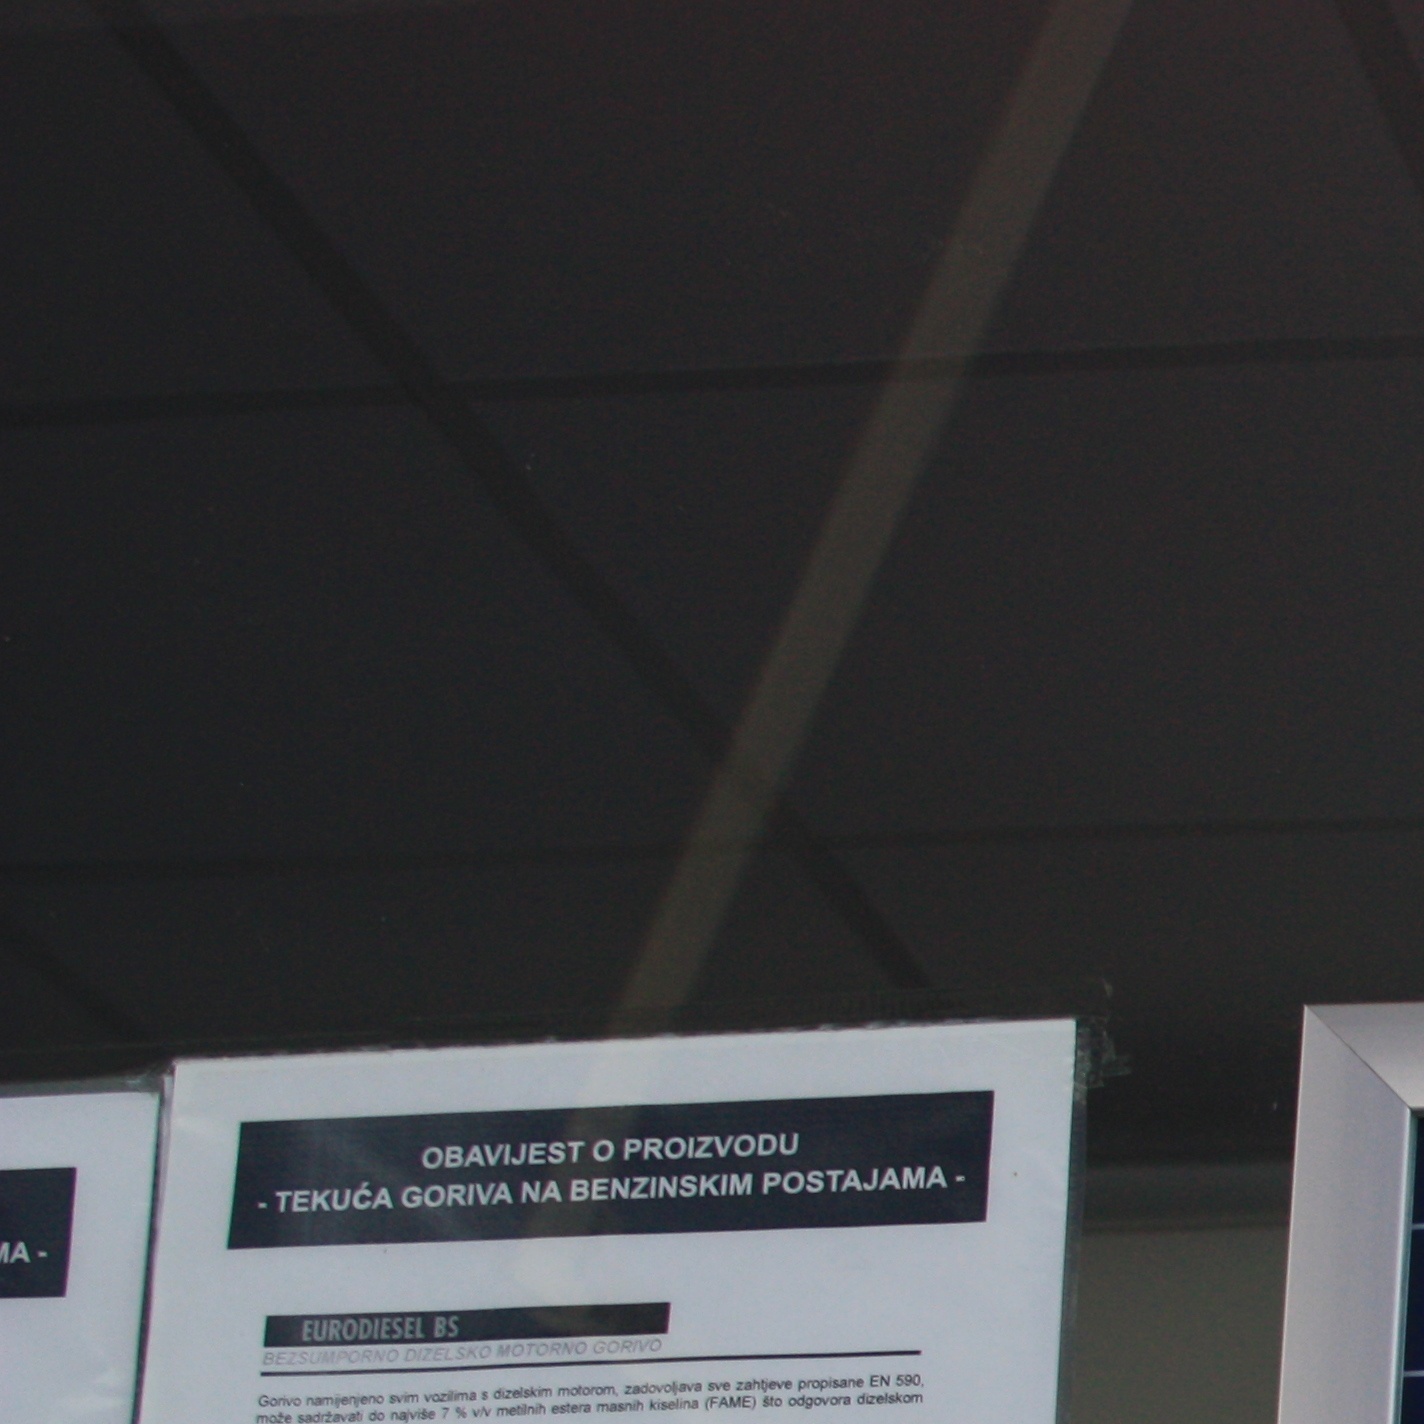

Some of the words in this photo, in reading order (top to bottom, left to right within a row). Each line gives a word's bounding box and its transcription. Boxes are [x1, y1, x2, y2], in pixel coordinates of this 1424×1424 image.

[422, 1141, 585, 1169] OBAVIJEST
[593, 1139, 614, 1162] O
[624, 1133, 798, 1161] PROIZVODU
[275, 1181, 393, 1213] TEKUĆA
[401, 1182, 513, 1208] GORIVA
[521, 1180, 562, 1204] NA
[569, 1173, 753, 1202] BENZINSKIM
[762, 1166, 947, 1195] POSTAJAMA
[302, 1316, 424, 1342] EURODIESEL
[433, 1316, 459, 1338] BS
[256, 1412, 292, 1424] može
[297, 1411, 363, 1424] sadržavati
[368, 1410, 385, 1422] do
[390, 1408, 435, 1423] najviše
[442, 1407, 449, 1417] 7
[472, 1406, 491, 1418] v/v
[496, 1403, 546, 1417] metilnih
[551, 1402, 591, 1414] estera
[596, 1399, 644, 1413] masnih
[649, 1398, 699, 1411] kiselina
[705, 1396, 756, 1411] (FAME)
[762, 1395, 782, 1408] što
[788, 1393, 851, 1410] odgovora
[857, 1391, 923, 1405] dizelskom
[258, 1394, 301, 1407] Gorivo
[306, 1395, 384, 1409] namijenjeno
[389, 1394, 419, 1404] svim
[424, 1390, 477, 1403] vozilima
[481, 1391, 488, 1401] s
[493, 1386, 552, 1399] dizelskim
[624, 1381, 702, 1401] zadovoljava
[708, 1382, 732, 1394] sve
[736, 1379, 792, 1397] zahtjeve
[798, 1377, 864, 1396] propisane
[869, 1376, 890, 1389] EN
